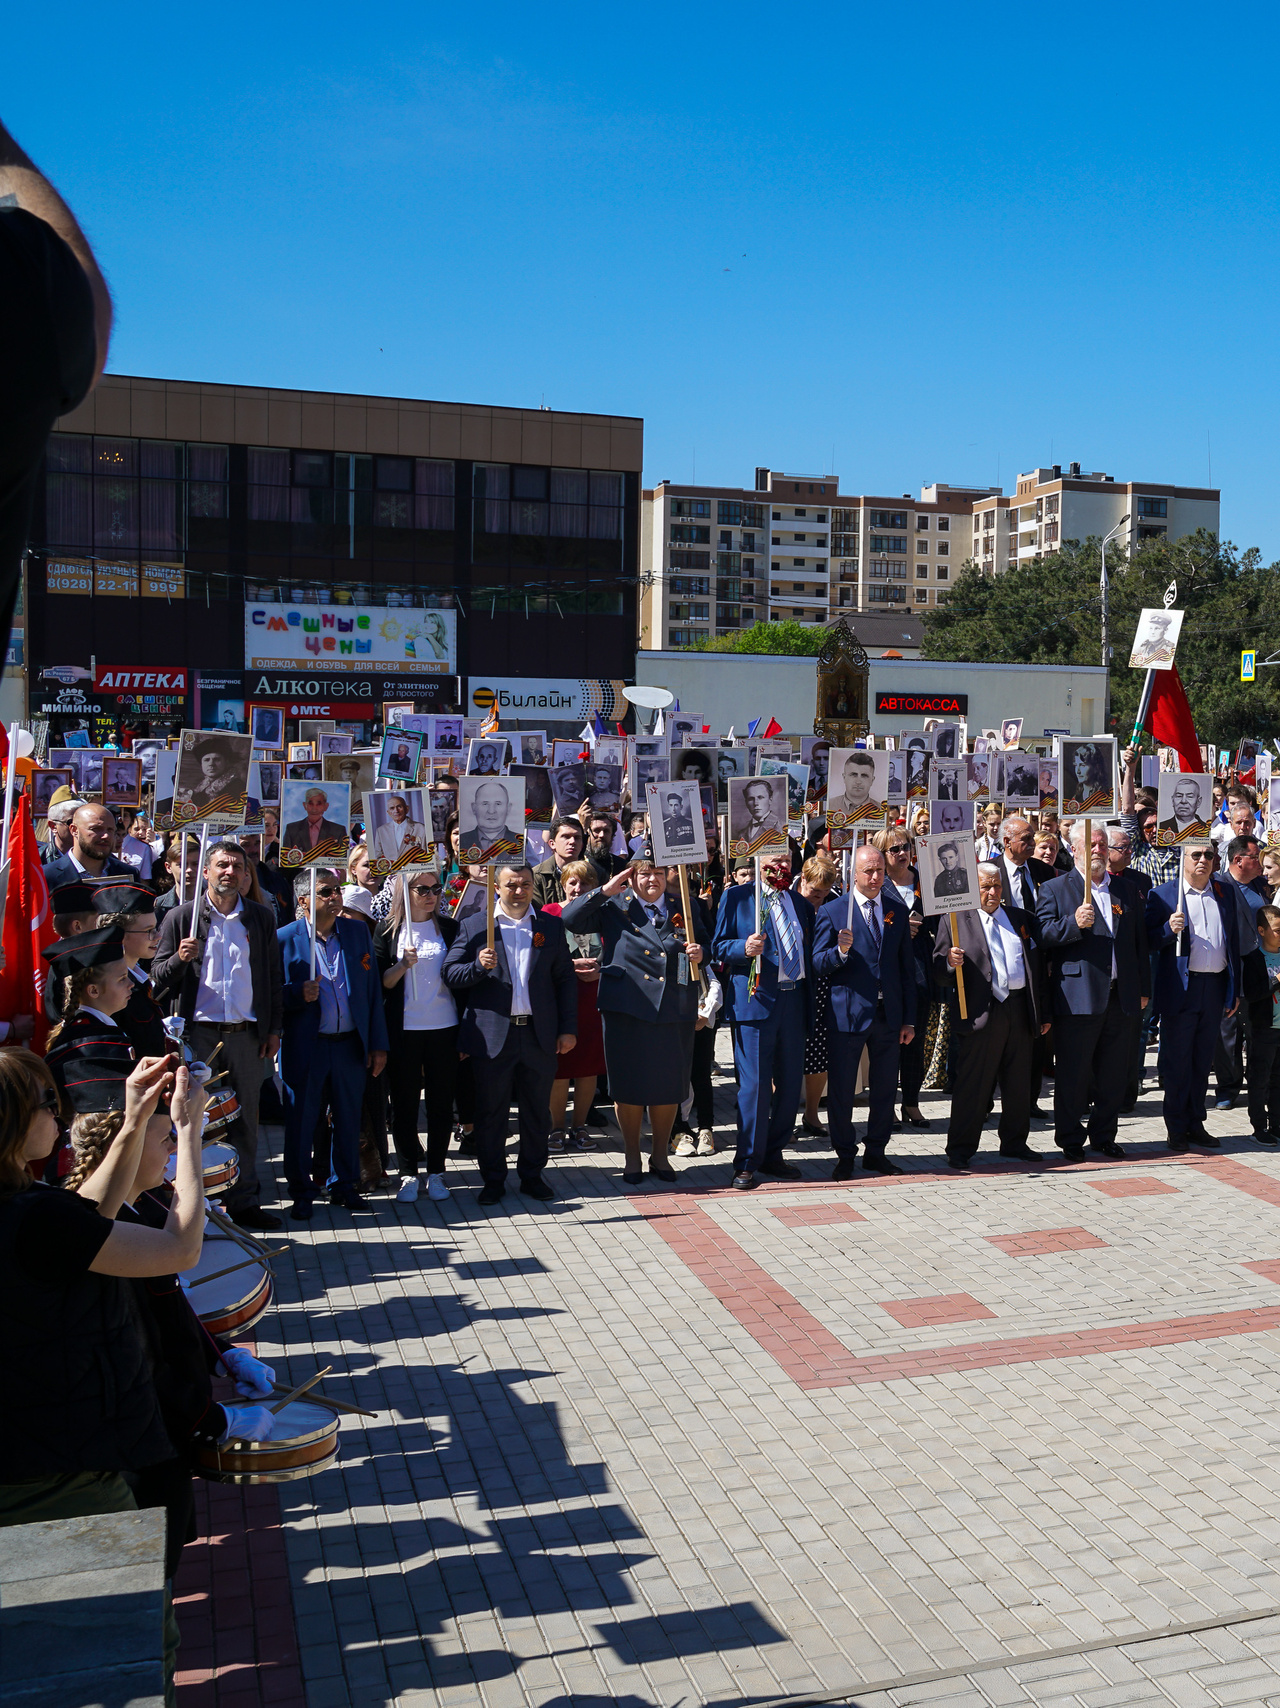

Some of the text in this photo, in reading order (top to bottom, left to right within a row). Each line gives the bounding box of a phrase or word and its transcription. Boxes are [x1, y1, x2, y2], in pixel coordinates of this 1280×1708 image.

[47, 578, 177, 593] 8(928) 22-11 999
[256, 659, 441, 672] ОДЕЖДА И ОБУВЬ ДЛЯ ВСЕЙ СЕМЬИ
[99, 672, 185, 688] АПТЕКА
[383, 681, 396, 690] От
[58, 687, 84, 696] КАФЕ
[383, 690, 435, 698] до простого
[499, 690, 572, 708] Билайн
[879, 697, 960, 711] АВТОКАССА
[41, 703, 102, 713] МИМИНО
[131, 704, 171, 714] ЦЕНЫ
[300, 705, 331, 715] МТС
[96, 718, 115, 726] ТЕЛ.
